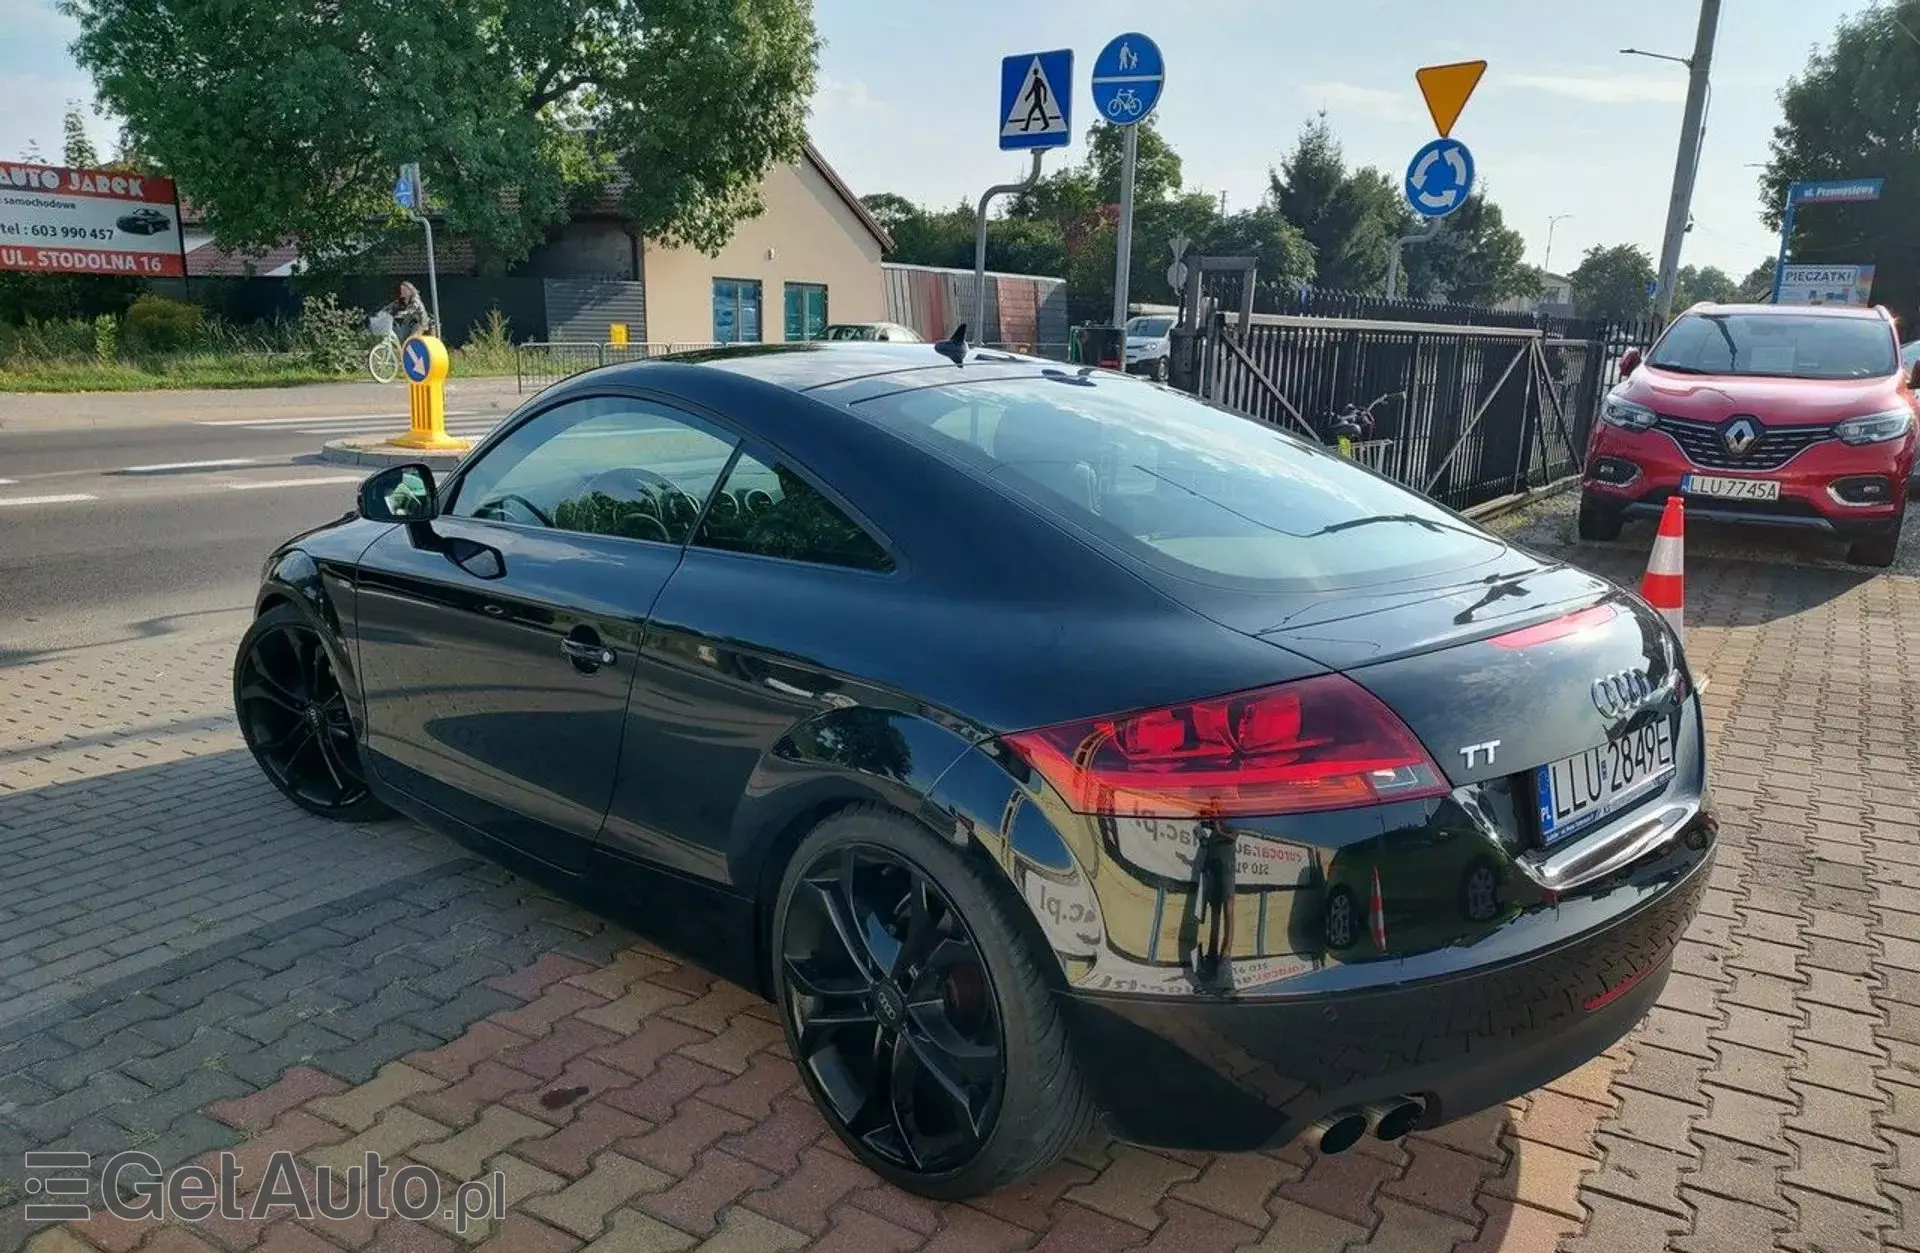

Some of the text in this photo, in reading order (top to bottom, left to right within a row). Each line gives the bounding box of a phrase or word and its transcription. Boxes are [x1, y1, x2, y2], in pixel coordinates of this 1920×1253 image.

[0, 167, 60, 189] AUTO
[4, 197, 76, 209] samochodowe
[1, 223, 20, 235] tel
[31, 224, 57, 237] 603
[61, 226, 87, 239] 990
[89, 228, 114, 240] 457
[2, 249, 162, 271] UL. STODOLNA 16
[1690, 477, 1722, 495] LLU
[1726, 481, 1776, 499] 7745A
[1460, 739, 1501, 769] TT
[1552, 747, 1602, 820] LLU
[1607, 714, 1671, 793] 2849E
